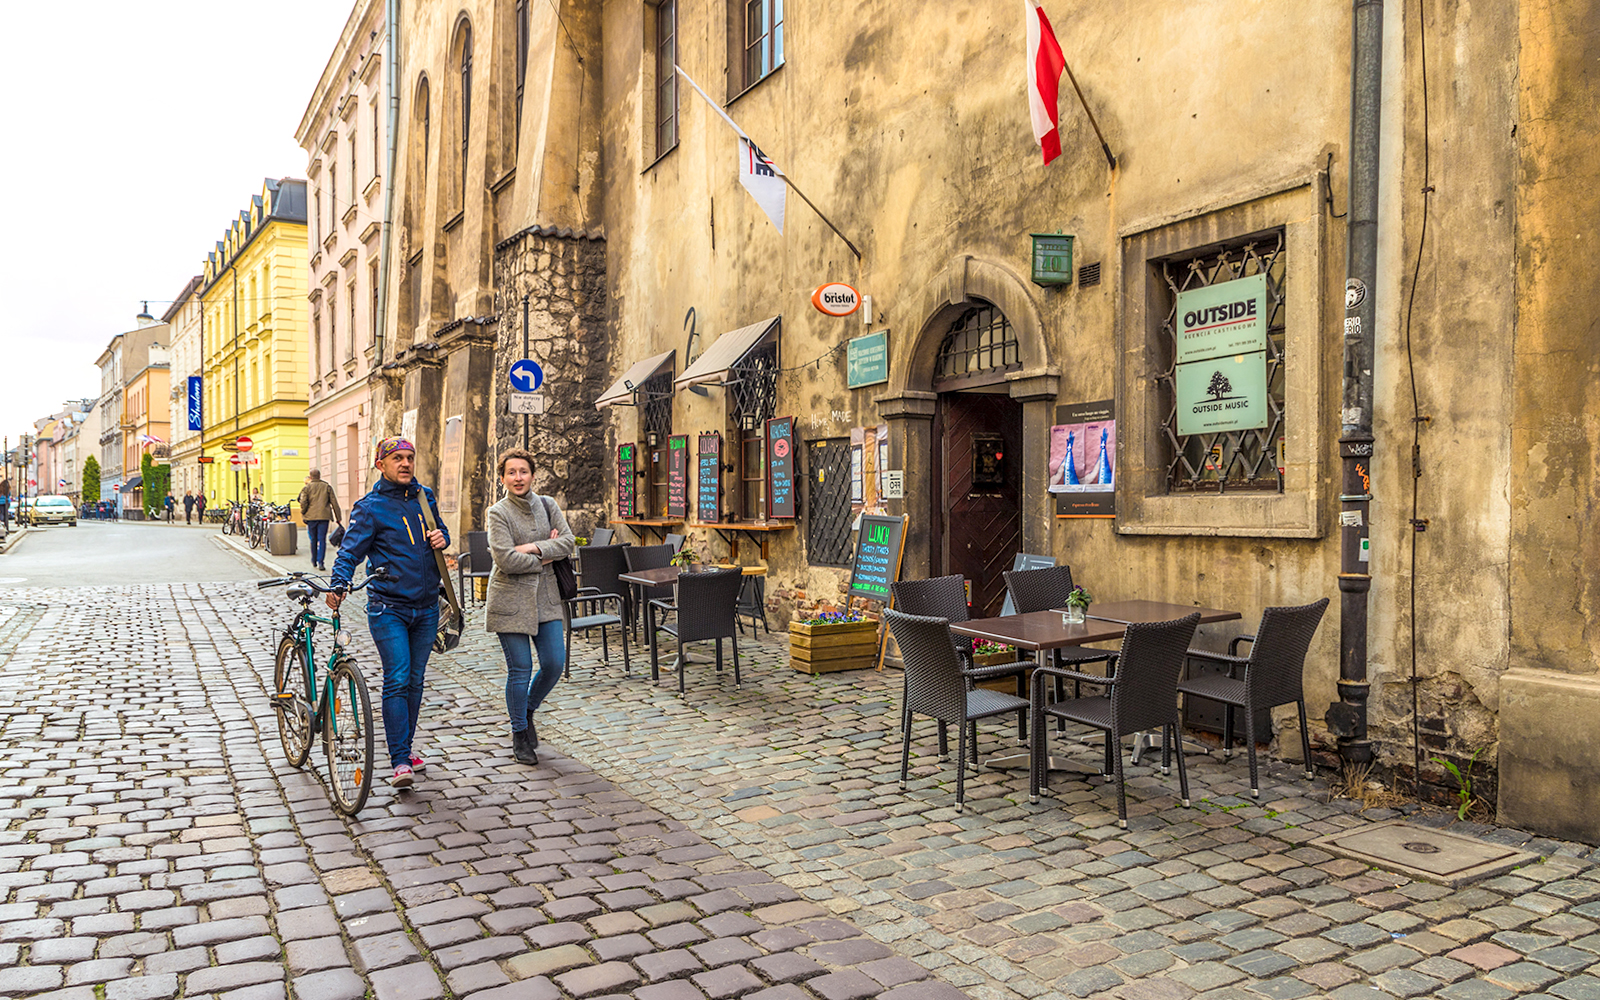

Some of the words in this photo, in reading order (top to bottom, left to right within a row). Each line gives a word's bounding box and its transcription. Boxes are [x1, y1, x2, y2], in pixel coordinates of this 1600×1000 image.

[1042, 256, 1061, 272] 40
[825, 293, 855, 303] bristot
[1184, 298, 1256, 328] OUTSIDE
[1214, 322, 1256, 334] CASTINGOWA
[189, 380, 201, 428] Shalom
[1192, 404, 1222, 413] OUTSIDE
[1225, 401, 1249, 410] MUSIC
[832, 410, 852, 423] MADE
[868, 524, 890, 545] LUNCH
